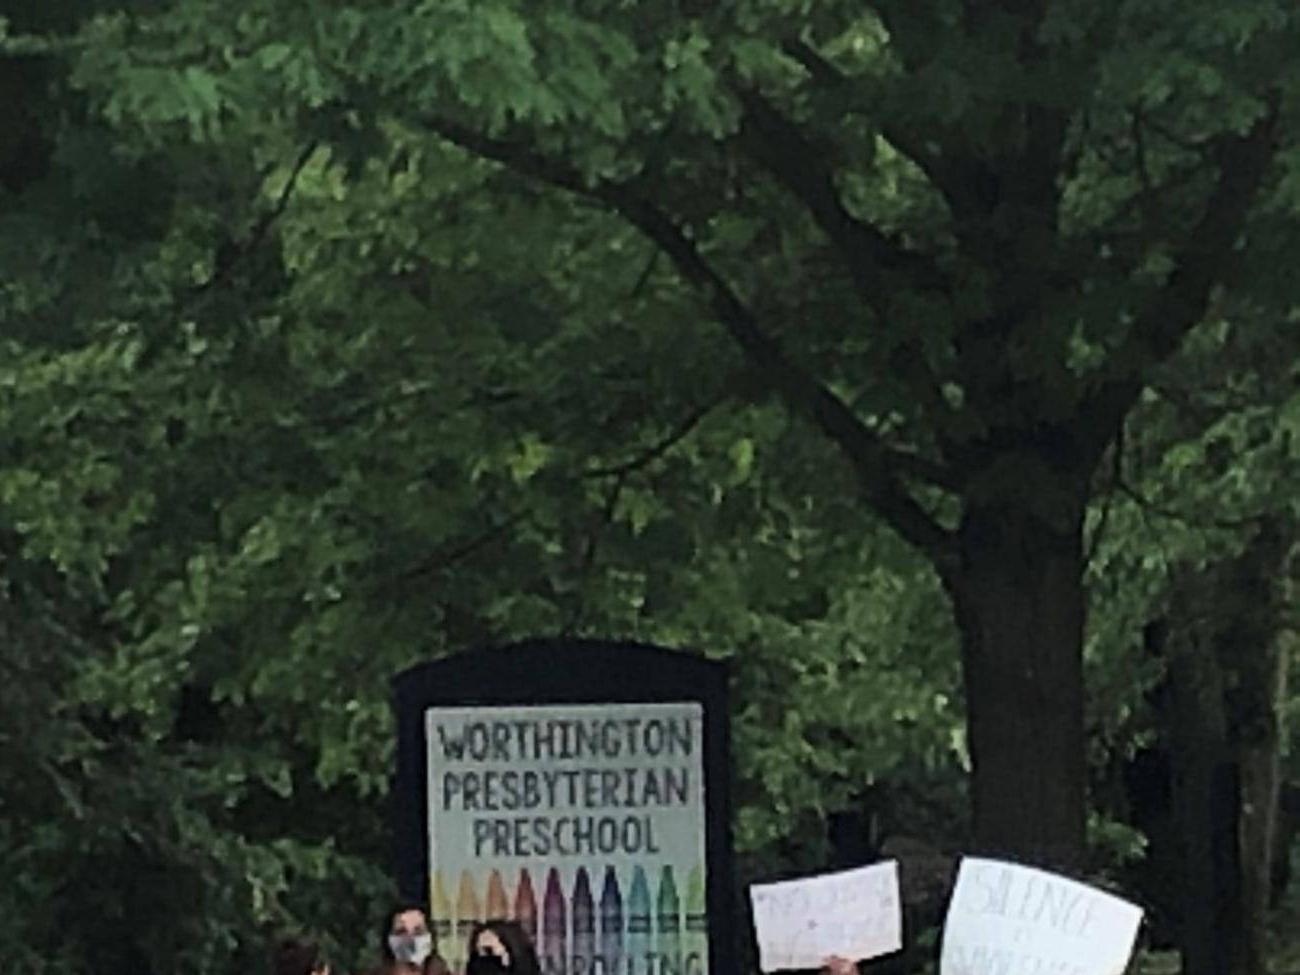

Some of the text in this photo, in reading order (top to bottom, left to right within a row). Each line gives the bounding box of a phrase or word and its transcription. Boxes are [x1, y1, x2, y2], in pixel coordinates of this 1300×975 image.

[438, 717, 693, 762] WORTHINGTON
[442, 767, 689, 811] PRESBYTERIAN
[473, 816, 661, 857] PRESCHOOL
